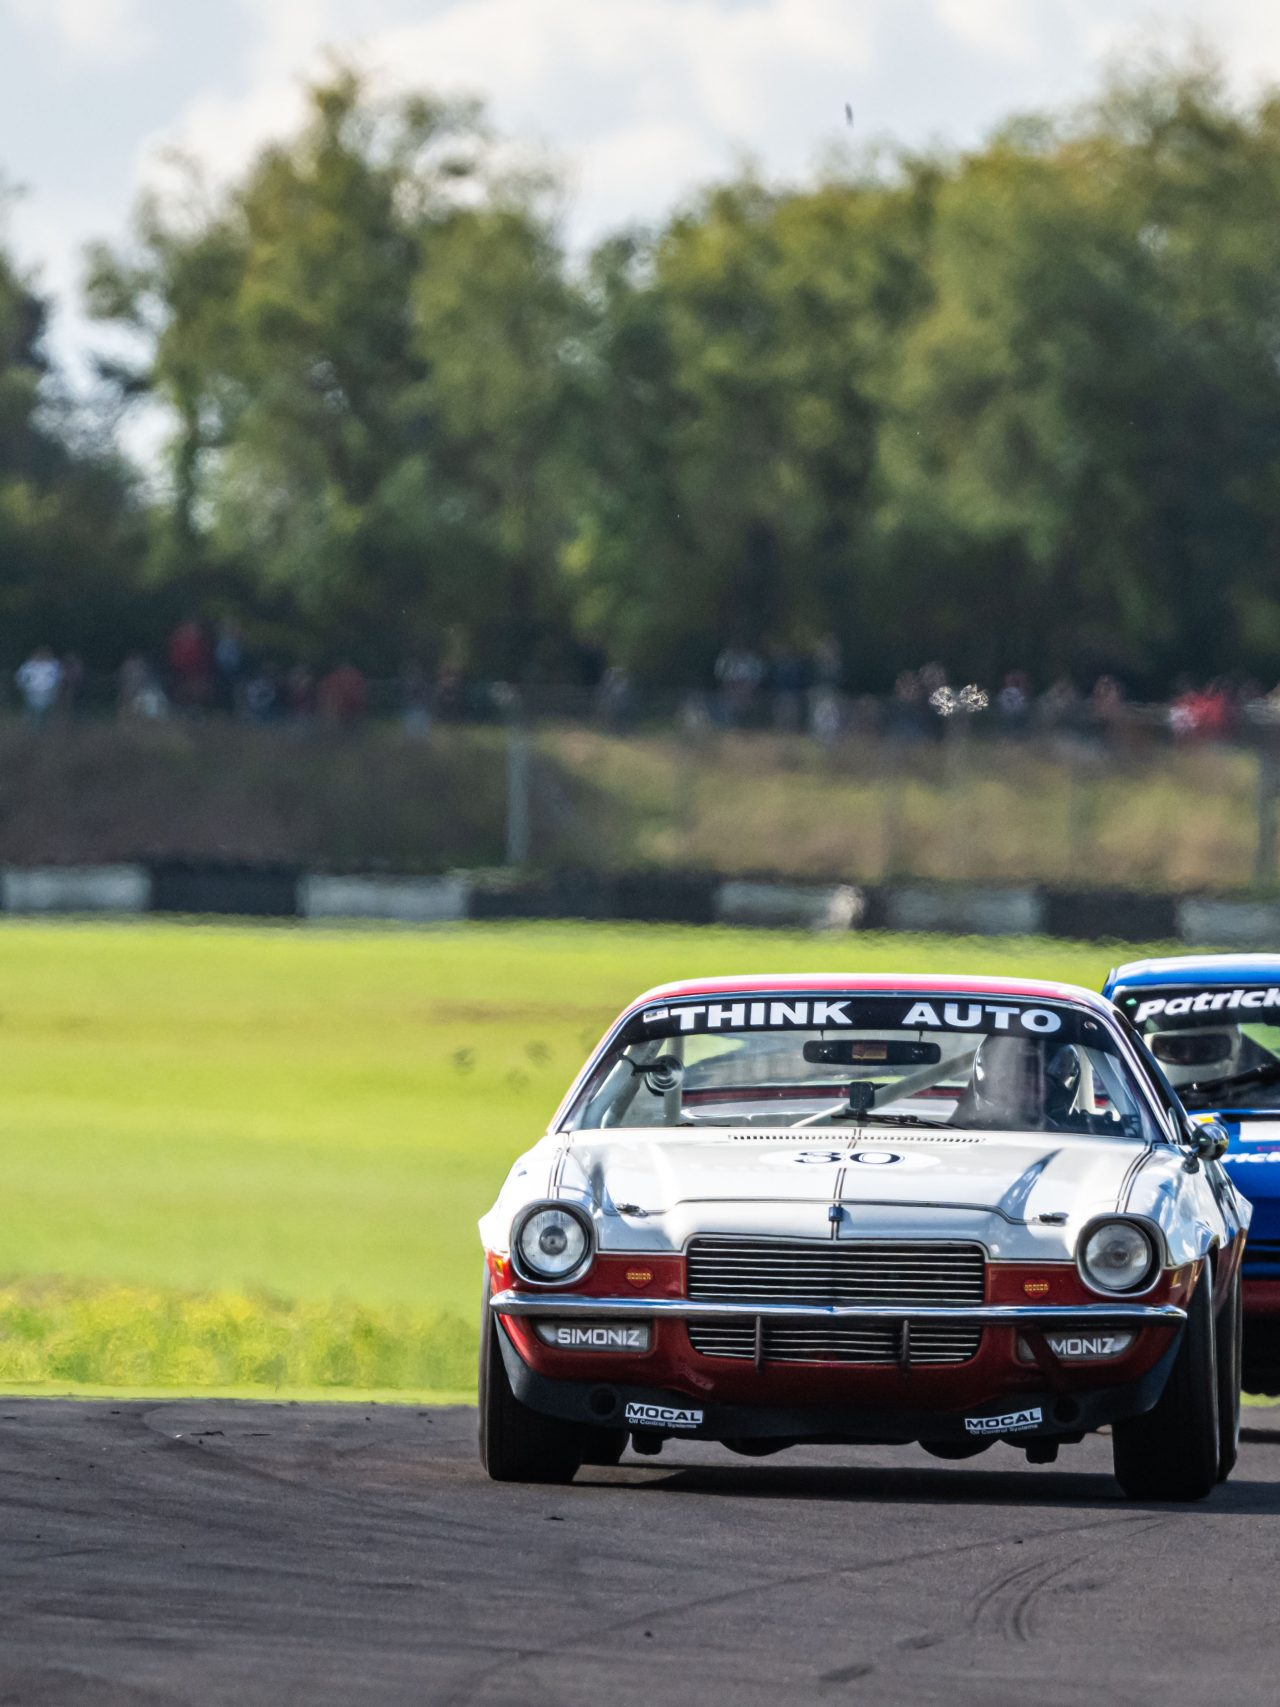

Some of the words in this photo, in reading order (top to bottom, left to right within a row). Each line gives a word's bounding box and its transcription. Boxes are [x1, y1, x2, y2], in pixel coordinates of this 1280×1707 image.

[669, 1000, 853, 1031] THINK
[901, 1002, 1062, 1033] AUTO
[793, 1151, 906, 1165] 30
[557, 1328, 641, 1346] SIMONIZ
[1049, 1337, 1115, 1355] MONIZ
[627, 1404, 702, 1422] MOCAL
[966, 1411, 1041, 1429] MOCAL
